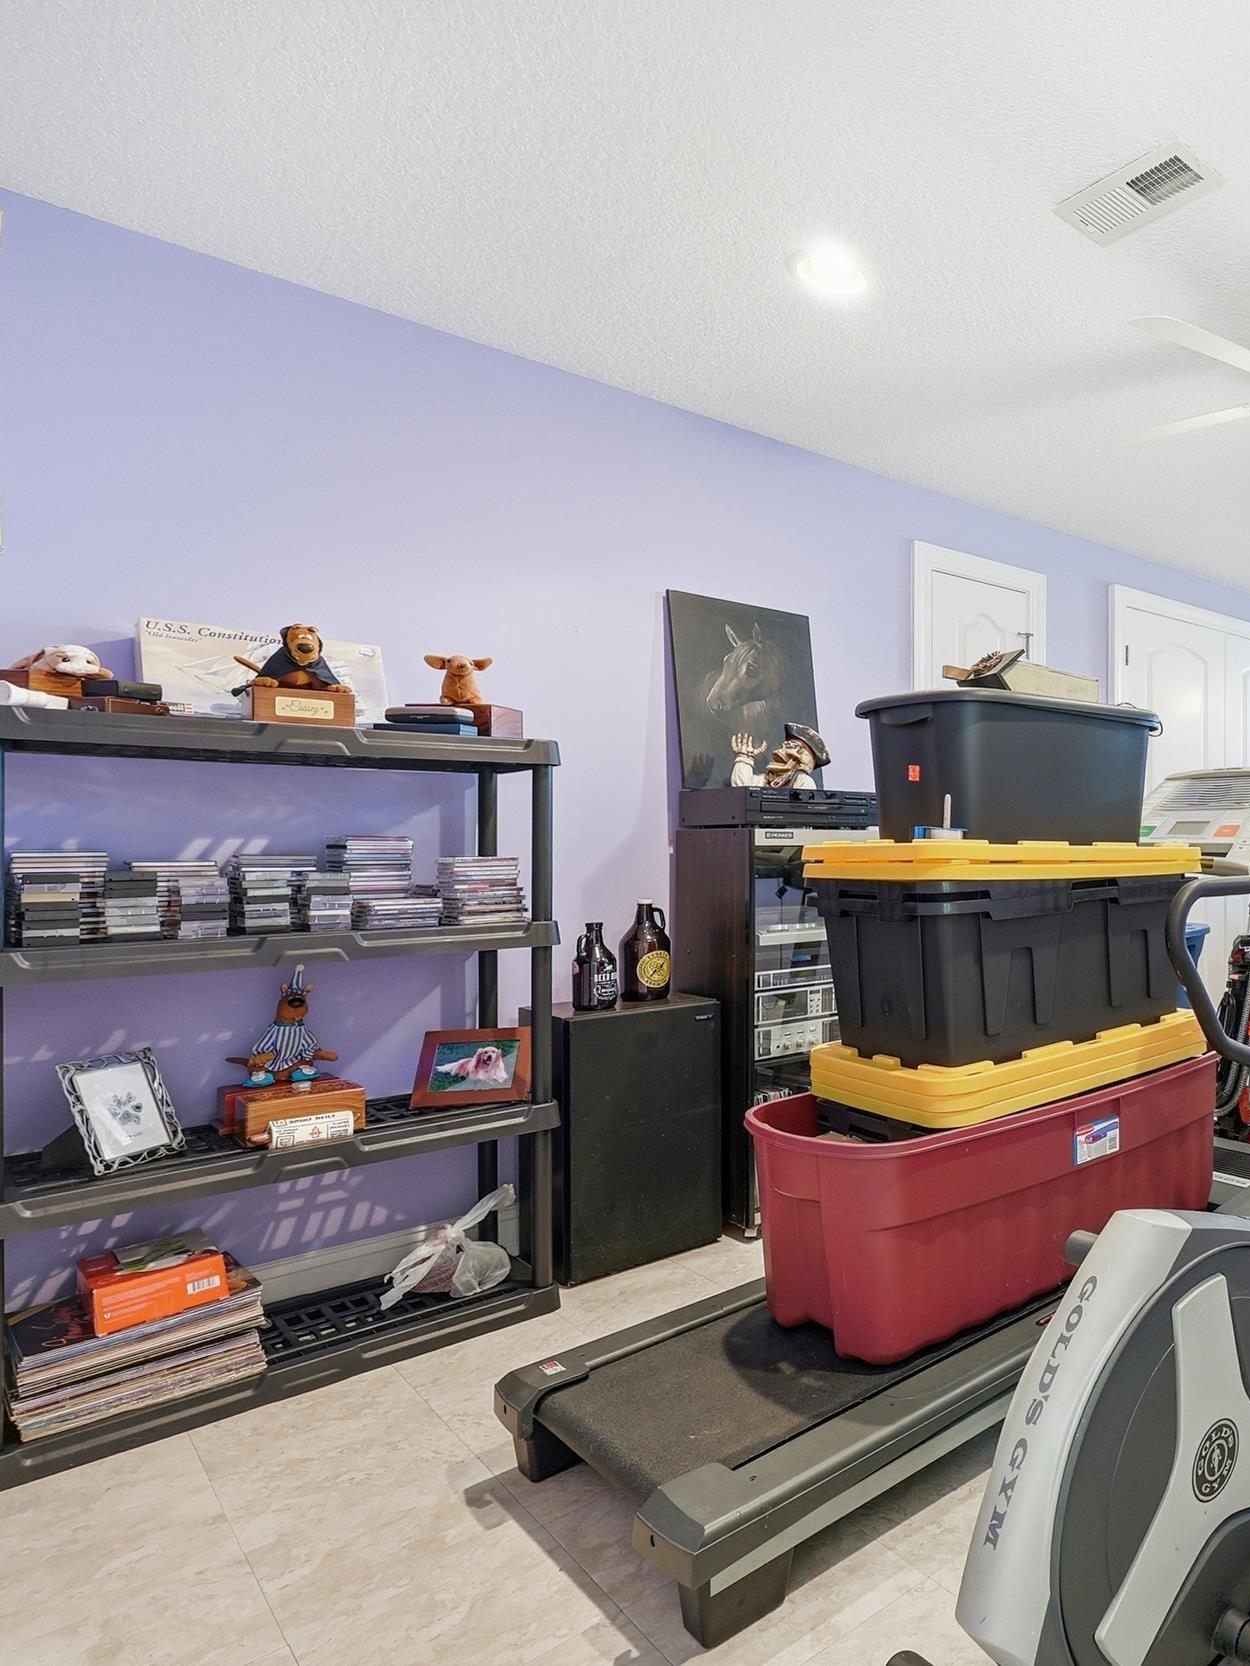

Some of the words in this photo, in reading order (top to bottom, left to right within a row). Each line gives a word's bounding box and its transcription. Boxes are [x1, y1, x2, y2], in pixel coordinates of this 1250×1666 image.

[145, 620, 191, 635] U.S.S.
[1025, 1275, 1098, 1426] GOLD'S
[983, 1437, 1028, 1551] GYM
[1201, 1458, 1233, 1493] GYM
